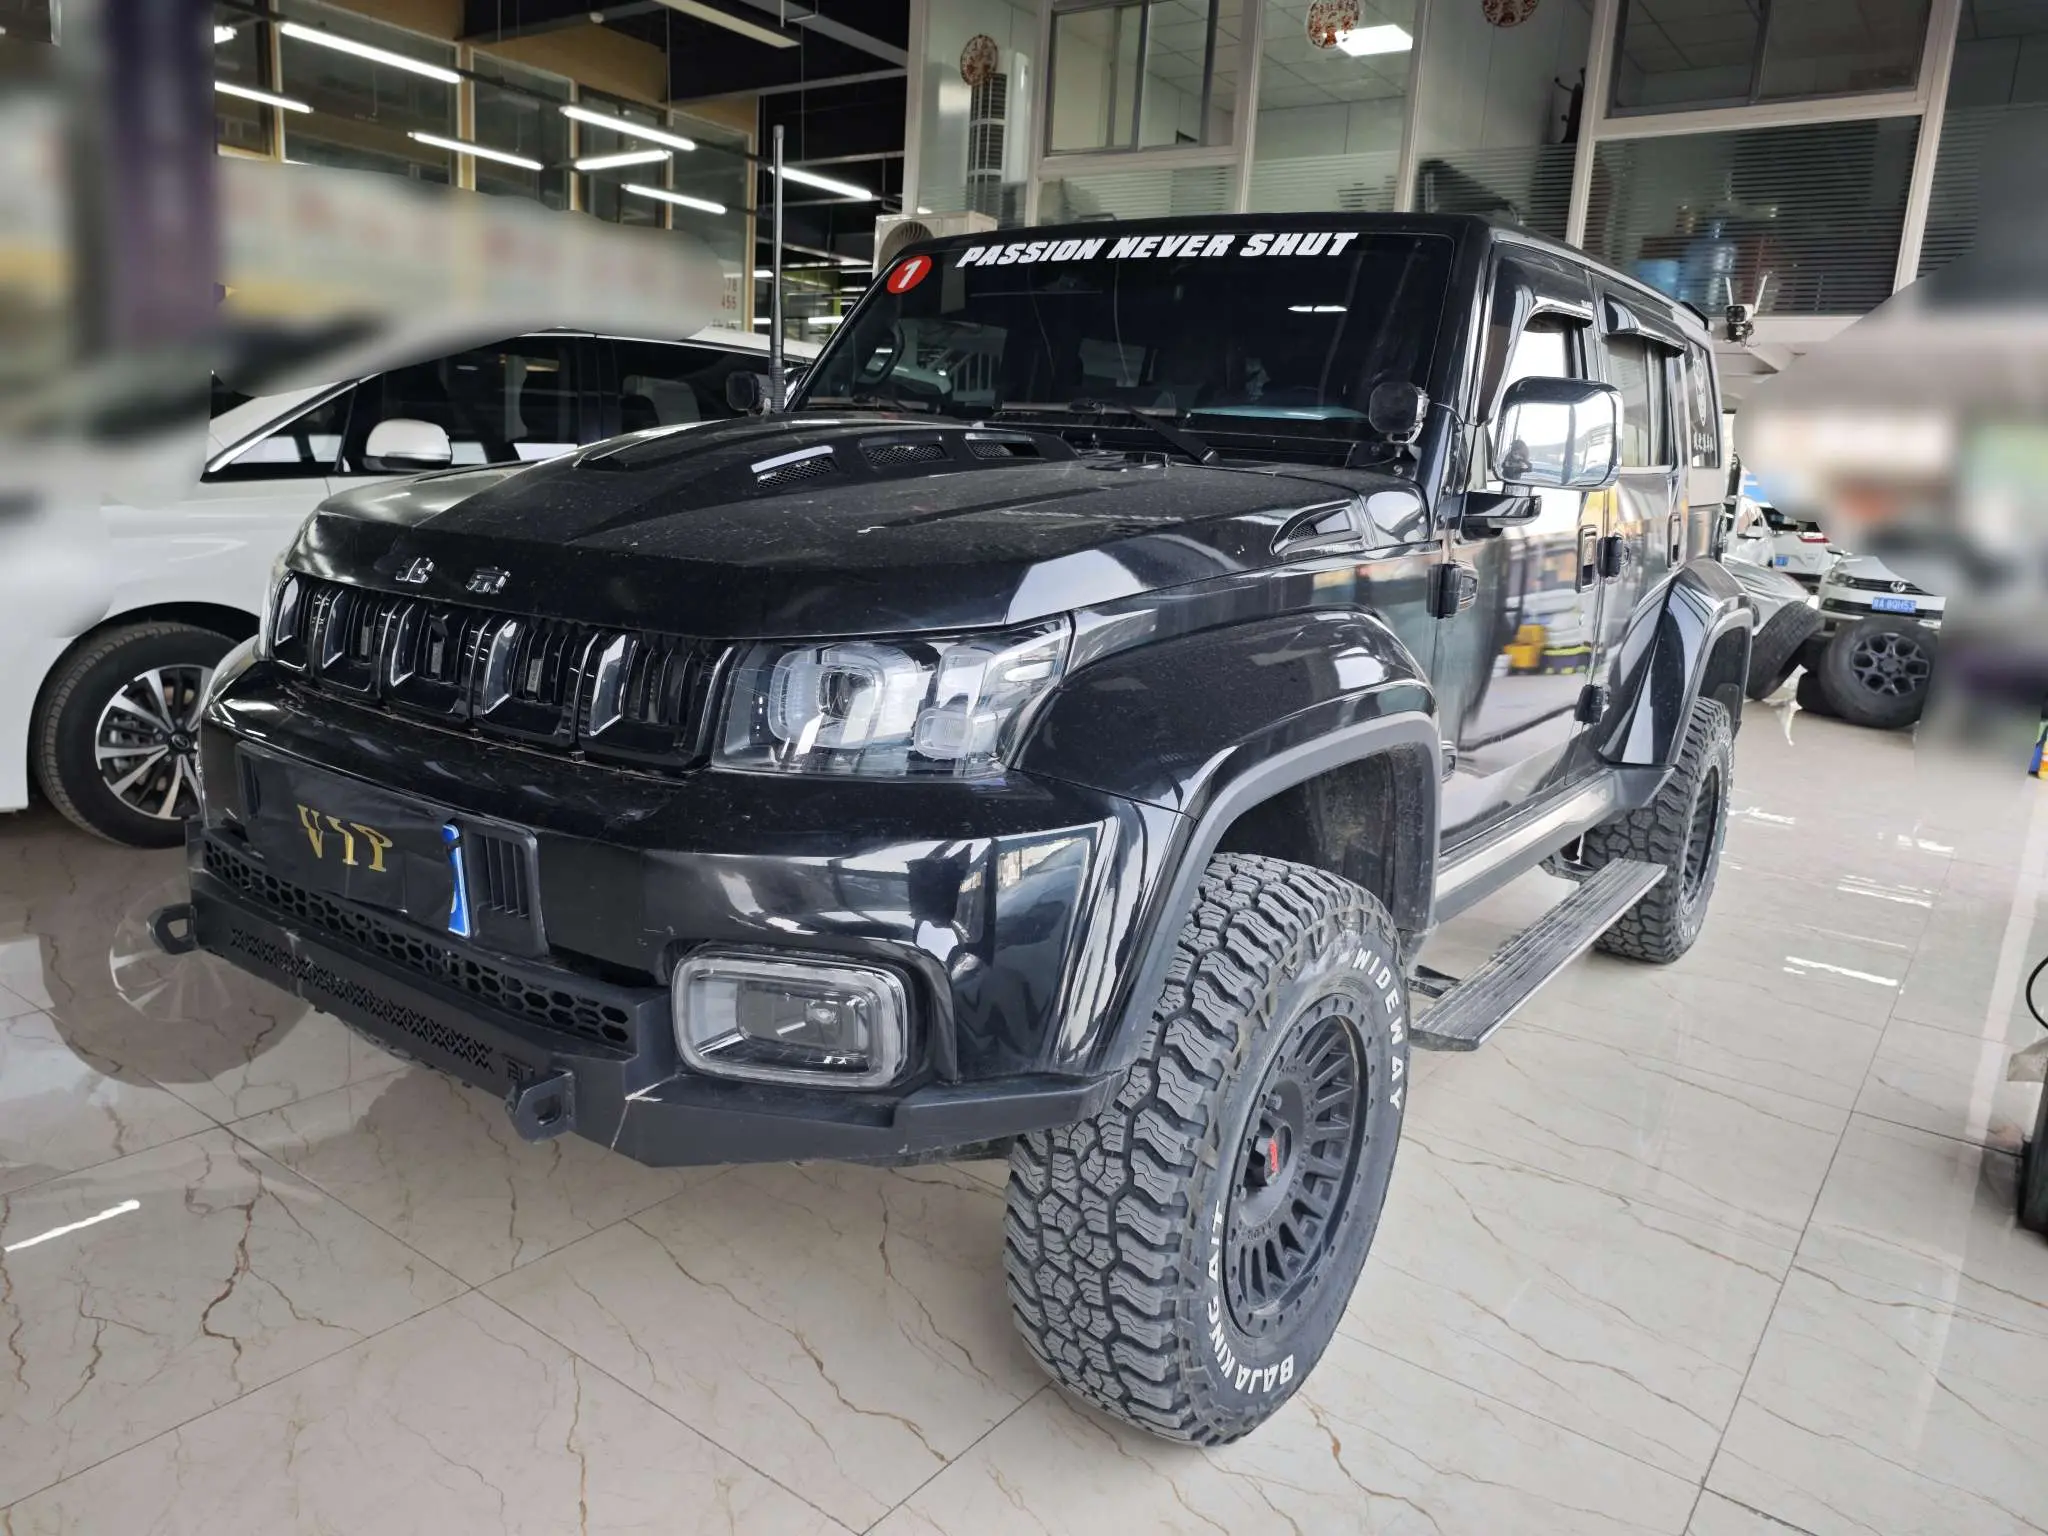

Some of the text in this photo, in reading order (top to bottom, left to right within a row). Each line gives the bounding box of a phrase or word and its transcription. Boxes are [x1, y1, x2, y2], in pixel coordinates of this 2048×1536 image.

[956, 232, 1358, 268] PASSION NEVER SHUT
[297, 804, 394, 873] VIP
[1352, 947, 1404, 1110] WIDEWAY
